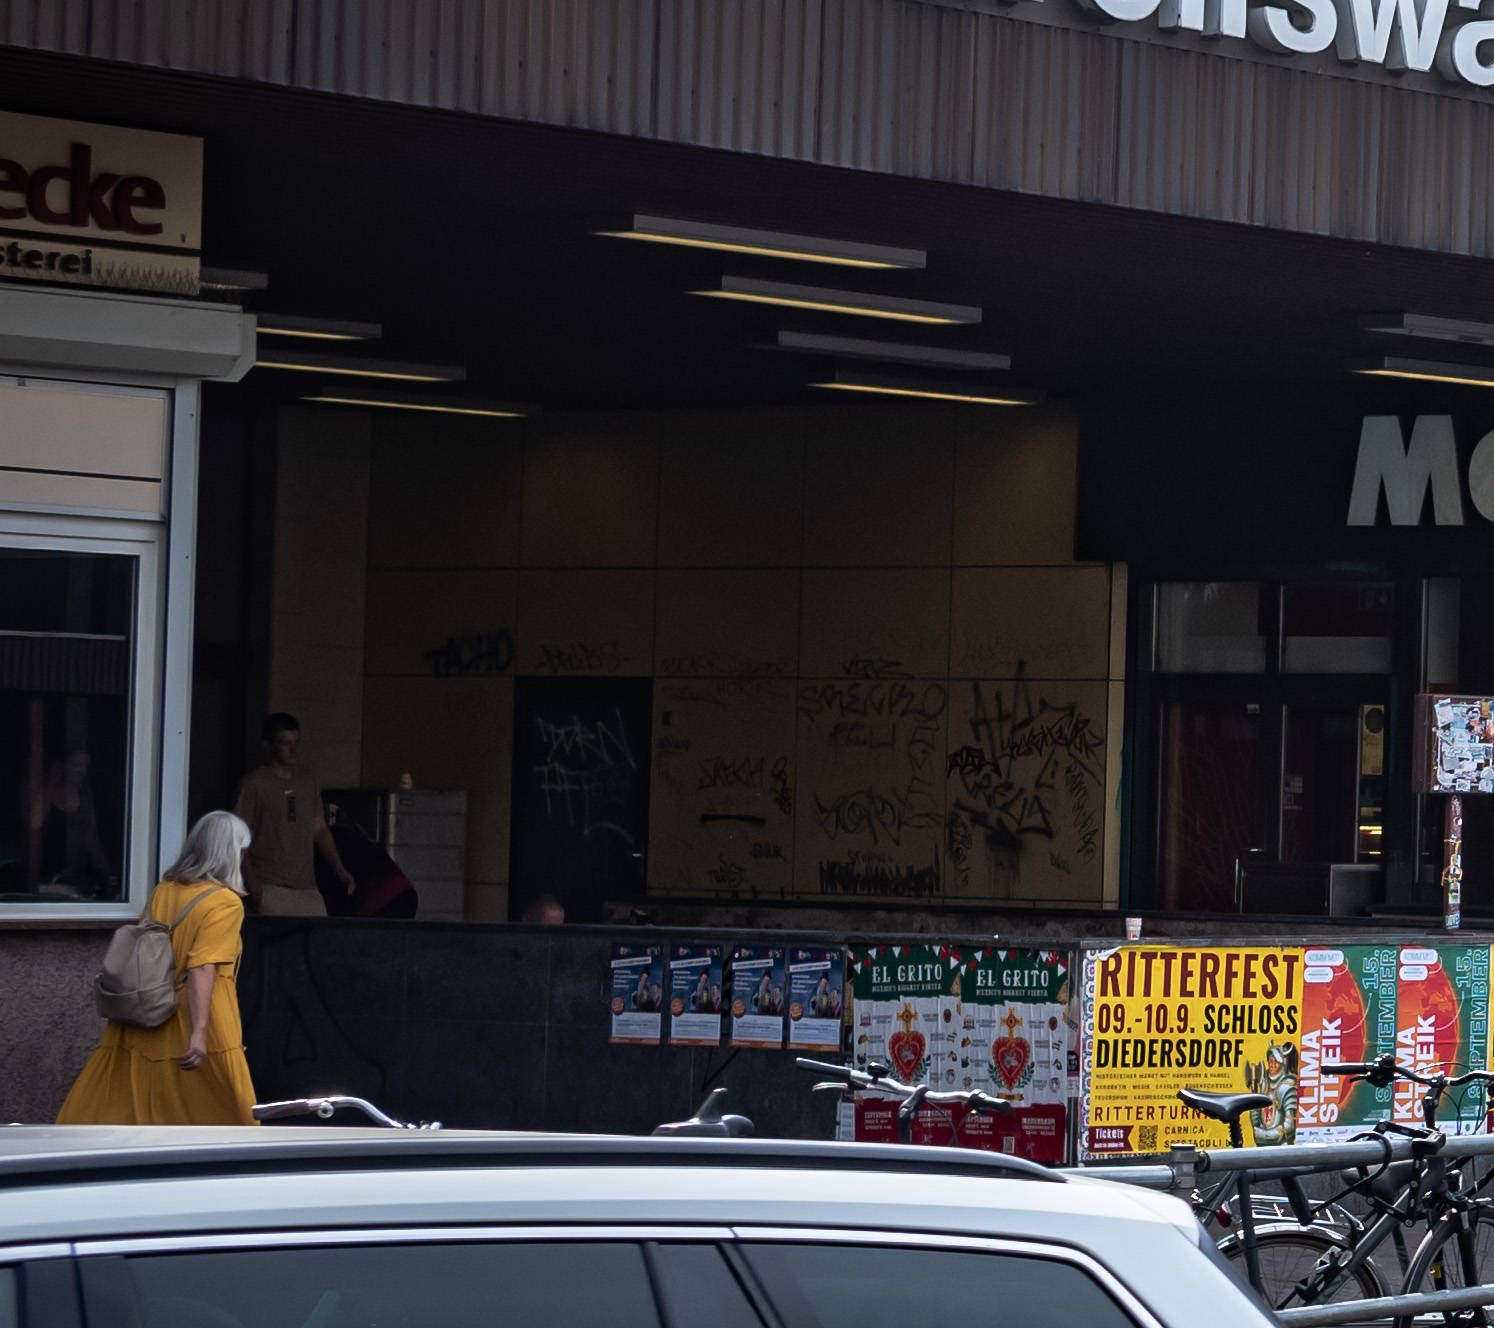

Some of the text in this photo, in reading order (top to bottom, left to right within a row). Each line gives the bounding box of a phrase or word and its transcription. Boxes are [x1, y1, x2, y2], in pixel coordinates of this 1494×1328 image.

[0, 241, 92, 274] terei
[872, 963, 942, 983] EL GRITO
[976, 969, 1049, 987] EL GRITO
[1100, 951, 1299, 999] RITTERFEST
[1363, 950, 1380, 990] 15.
[1456, 949, 1473, 988] 15.
[1203, 1004, 1298, 1034] SCHLOSS
[1096, 1038, 1244, 1068] DIEDERSDORF
[1299, 1029, 1322, 1124] KLIMA
[1394, 1026, 1416, 1119] KLIMA
[1095, 1128, 1124, 1139] Tickets
